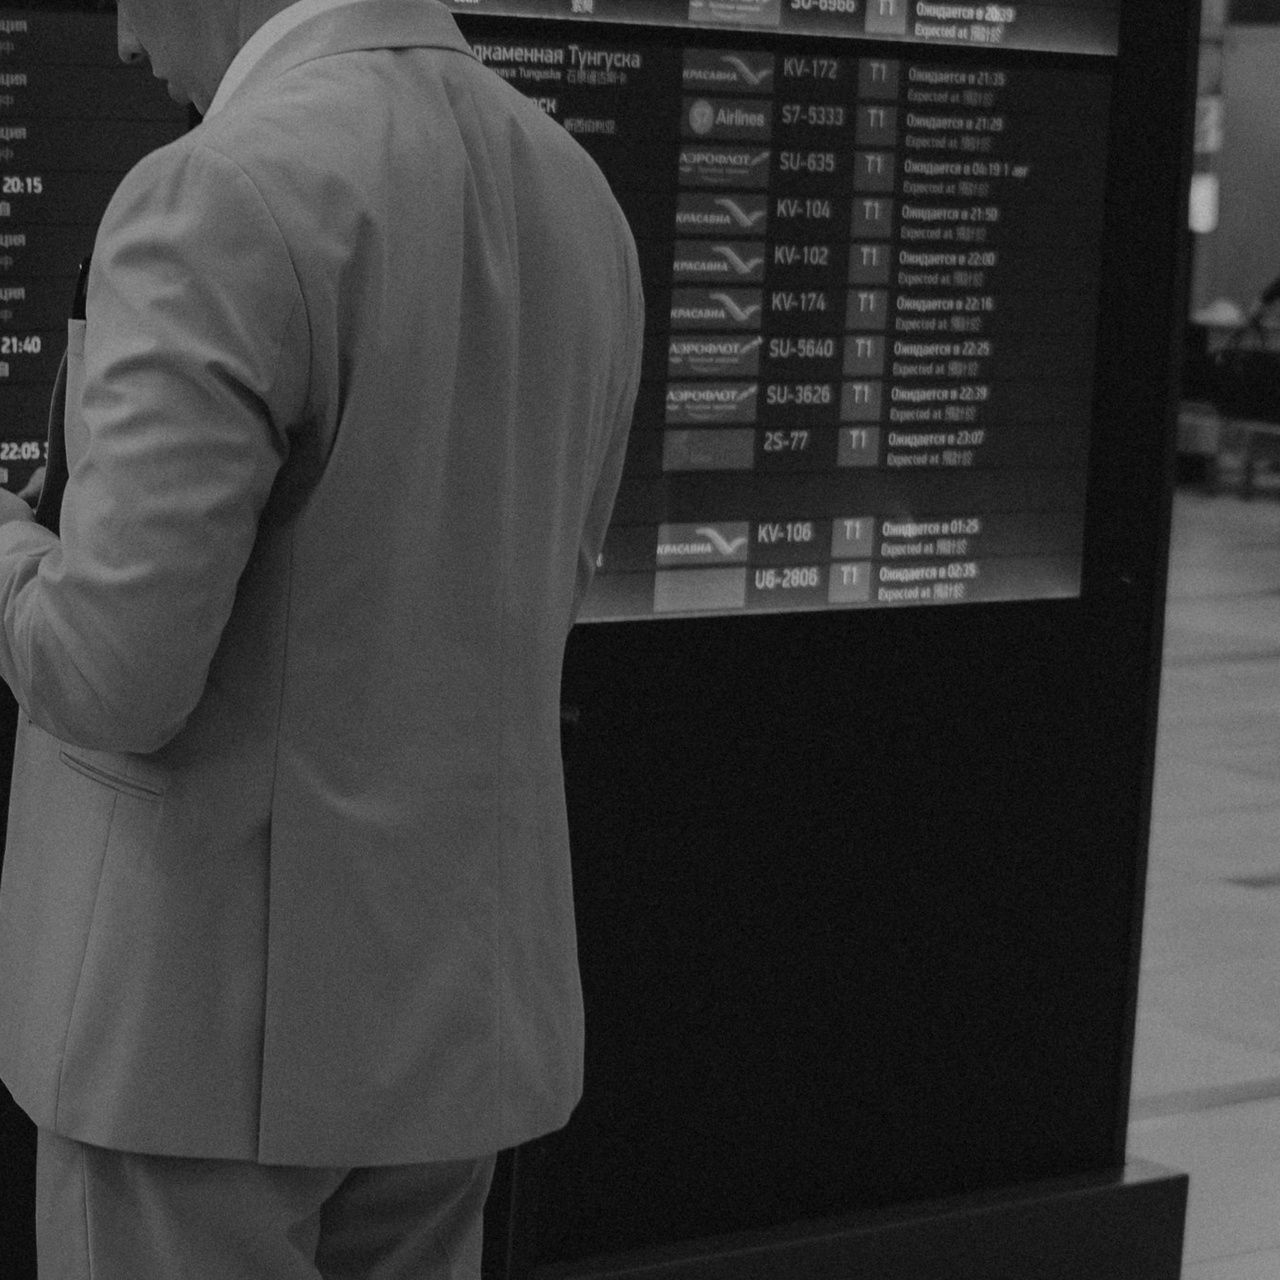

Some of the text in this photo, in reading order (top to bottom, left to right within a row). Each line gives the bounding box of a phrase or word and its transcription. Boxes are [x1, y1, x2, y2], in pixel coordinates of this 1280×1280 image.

[472, 43, 641, 72] дкаменная Тунгуска
[784, 57, 838, 80] KV-172
[780, 151, 835, 172] SU-635
[2, 176, 43, 194] 20:15
[777, 198, 830, 219] KV-104
[774, 245, 829, 266] KV-102
[772, 291, 826, 311] KV-174
[1, 336, 41, 354] 21:40
[769, 338, 834, 358] SU-5640
[763, 430, 808, 452] 2S-77
[757, 522, 812, 543] KV-106
